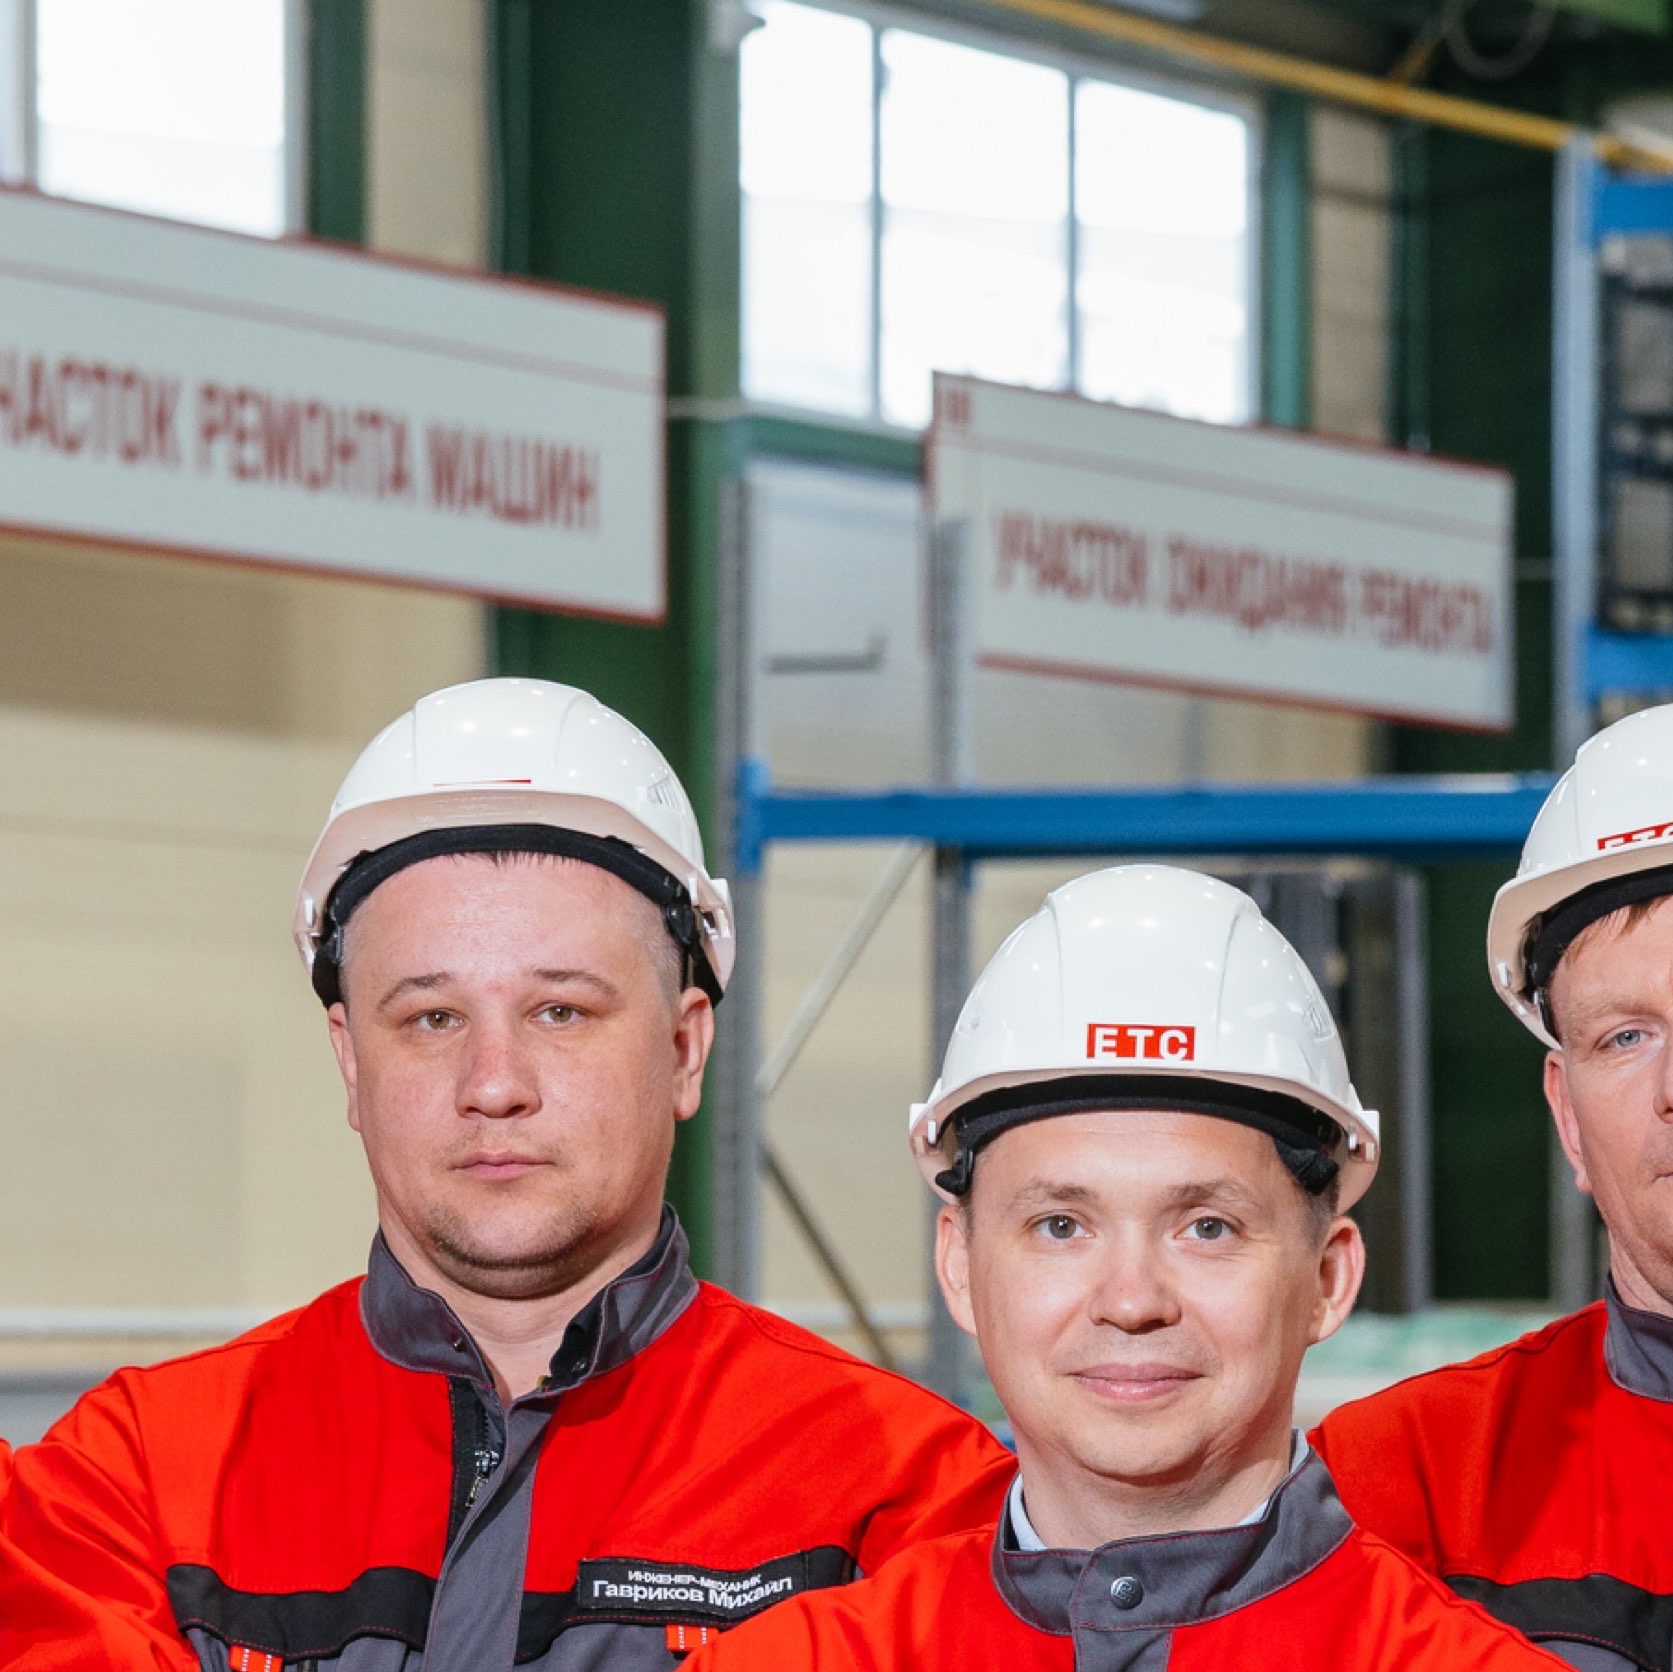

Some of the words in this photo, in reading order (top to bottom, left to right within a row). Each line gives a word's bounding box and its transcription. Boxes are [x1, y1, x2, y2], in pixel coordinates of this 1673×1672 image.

[196, 382, 414, 500] РЕМОНТА
[424, 422, 601, 532] МАШИН
[593, 1579, 704, 1602] Гавриков
[709, 1576, 793, 1609] Михаил
